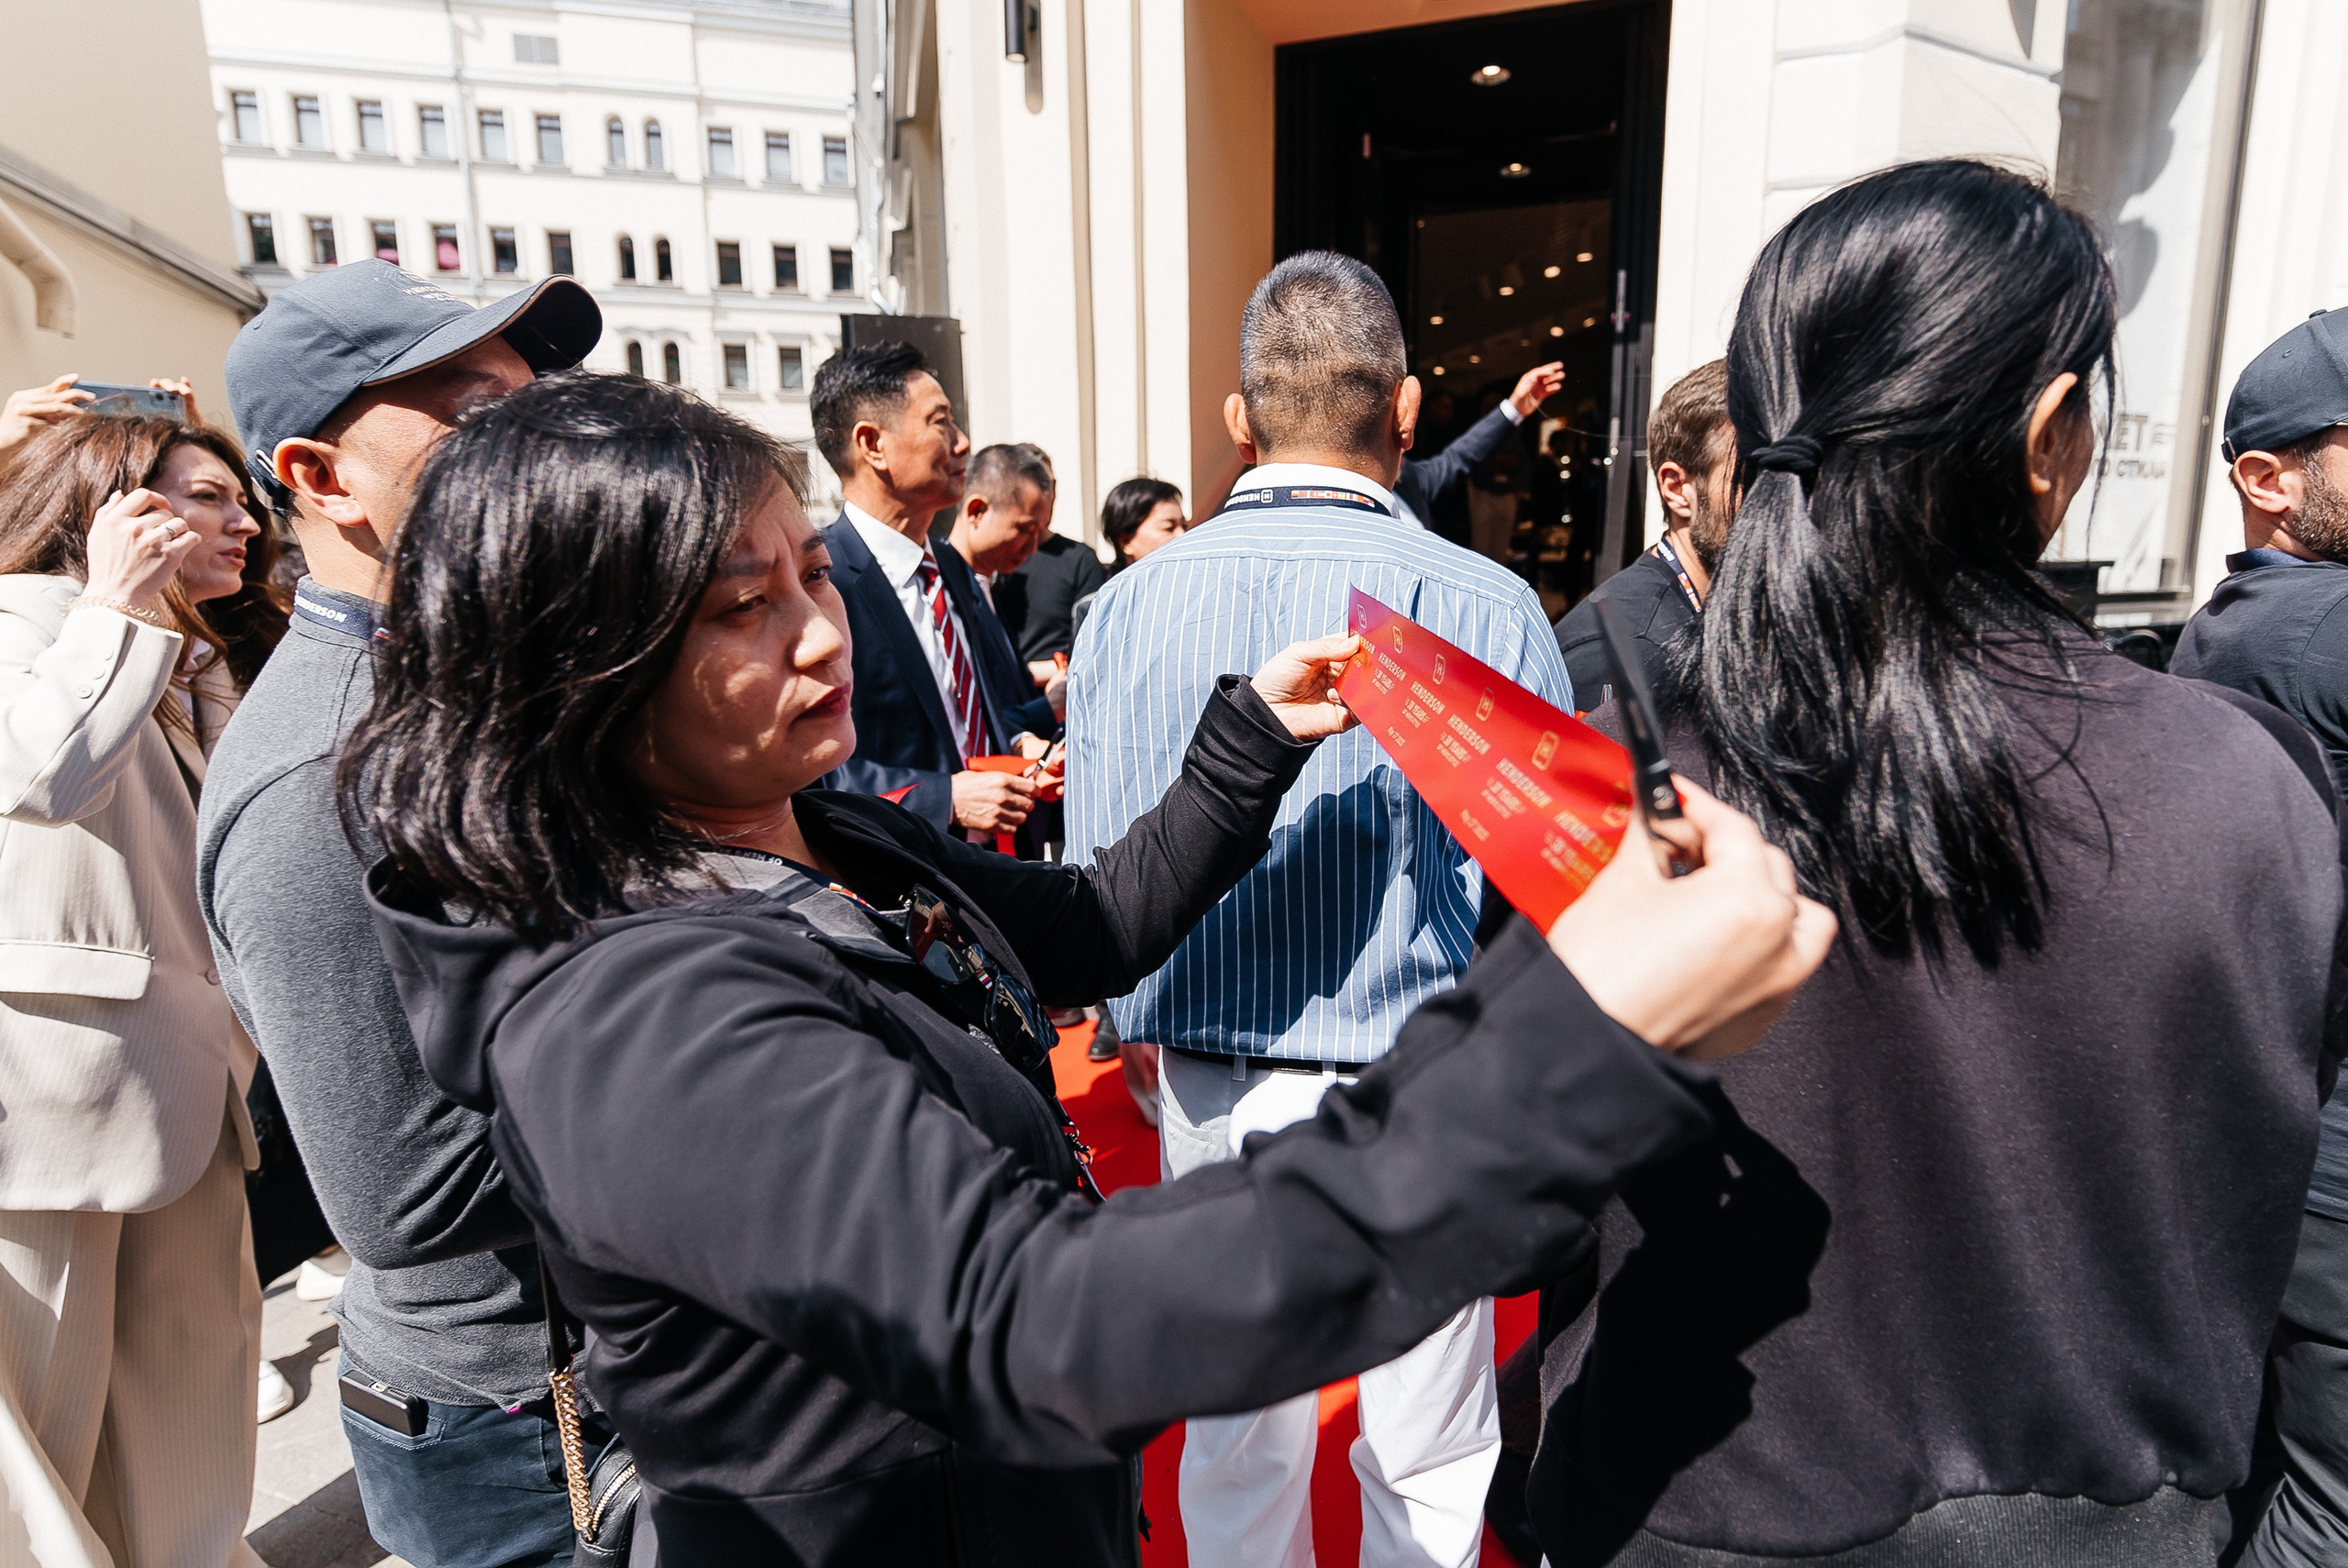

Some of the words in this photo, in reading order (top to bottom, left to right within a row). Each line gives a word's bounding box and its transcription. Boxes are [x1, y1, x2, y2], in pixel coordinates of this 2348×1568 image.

[1378, 652, 1407, 681] HENDERSON
[1410, 680, 1445, 715] HENDERSON
[1446, 713, 1491, 756] HENDERSON
